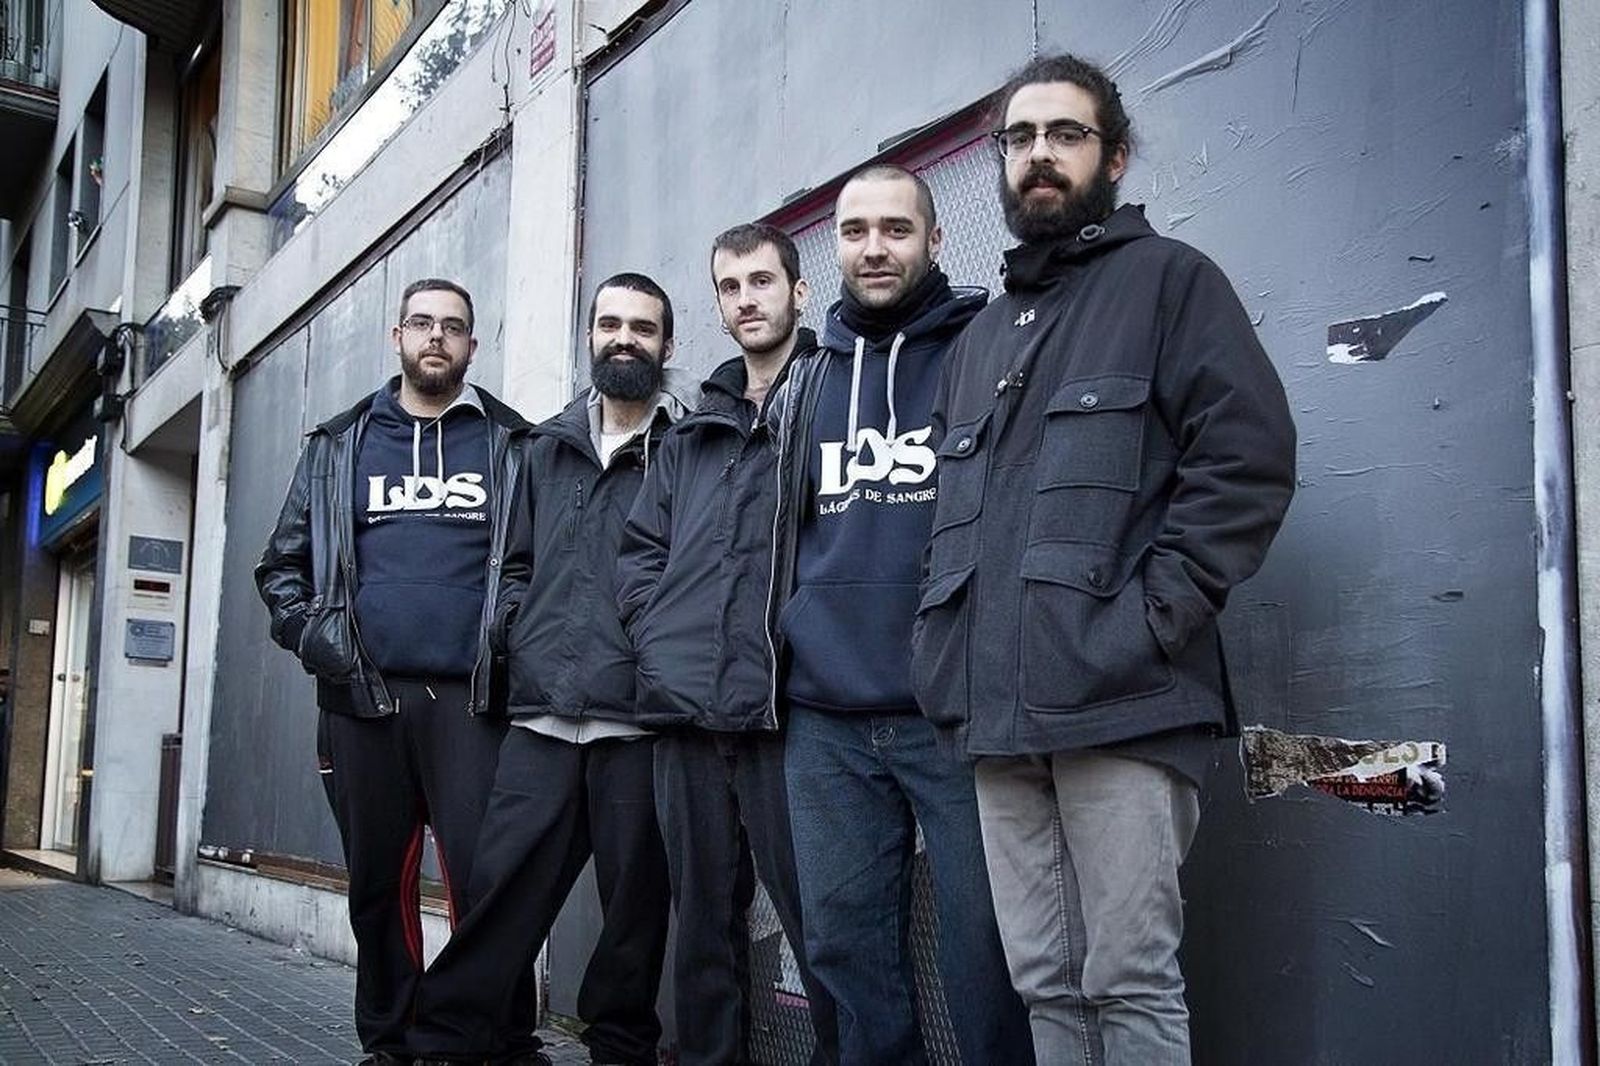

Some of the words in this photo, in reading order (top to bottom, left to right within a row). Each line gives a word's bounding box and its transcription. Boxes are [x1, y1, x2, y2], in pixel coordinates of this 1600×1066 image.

[366, 472, 487, 512] LDS
[865, 488, 882, 502] DE
[886, 487, 937, 504] SANGRE
